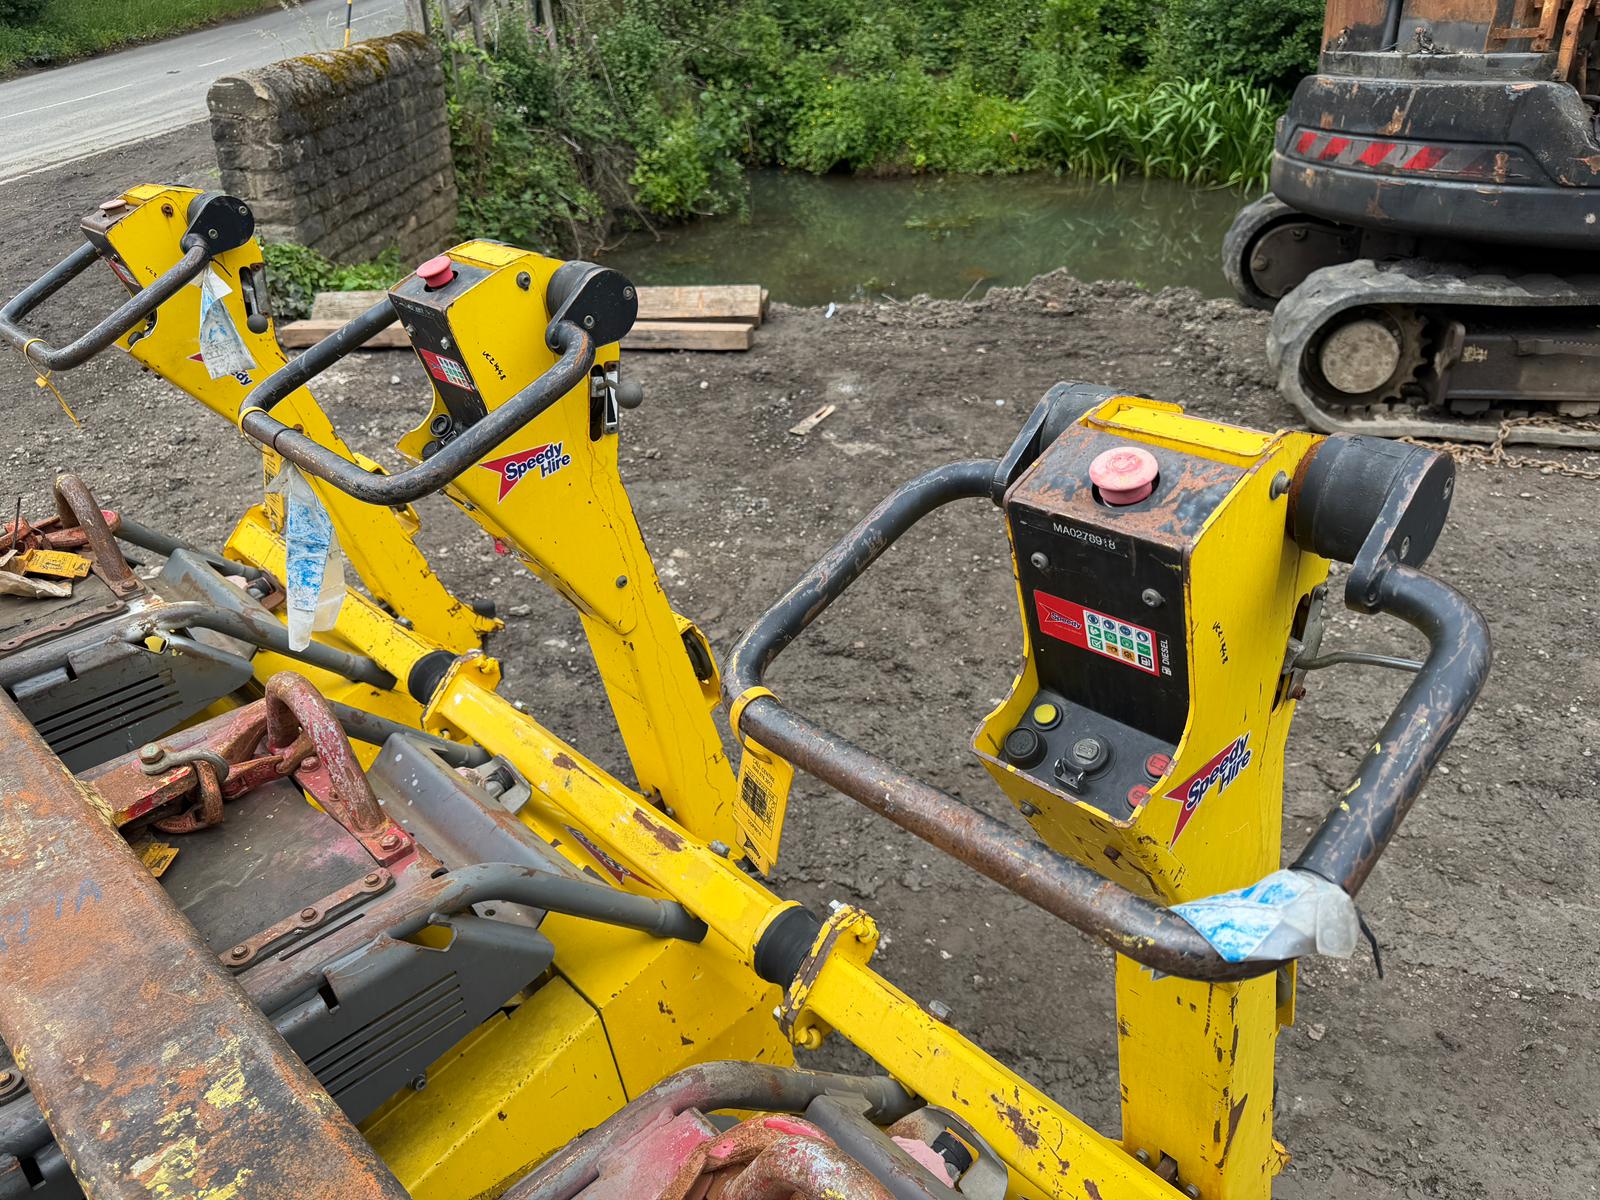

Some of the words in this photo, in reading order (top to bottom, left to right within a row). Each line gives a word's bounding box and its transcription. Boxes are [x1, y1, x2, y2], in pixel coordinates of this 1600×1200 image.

[505, 441, 562, 481] Speedy
[540, 454, 571, 479] Hire
[1050, 611, 1082, 630] Speedy
[1160, 639, 1170, 666] DIESEL
[1186, 730, 1251, 810] Speedy
[1218, 749, 1252, 796] Hire
